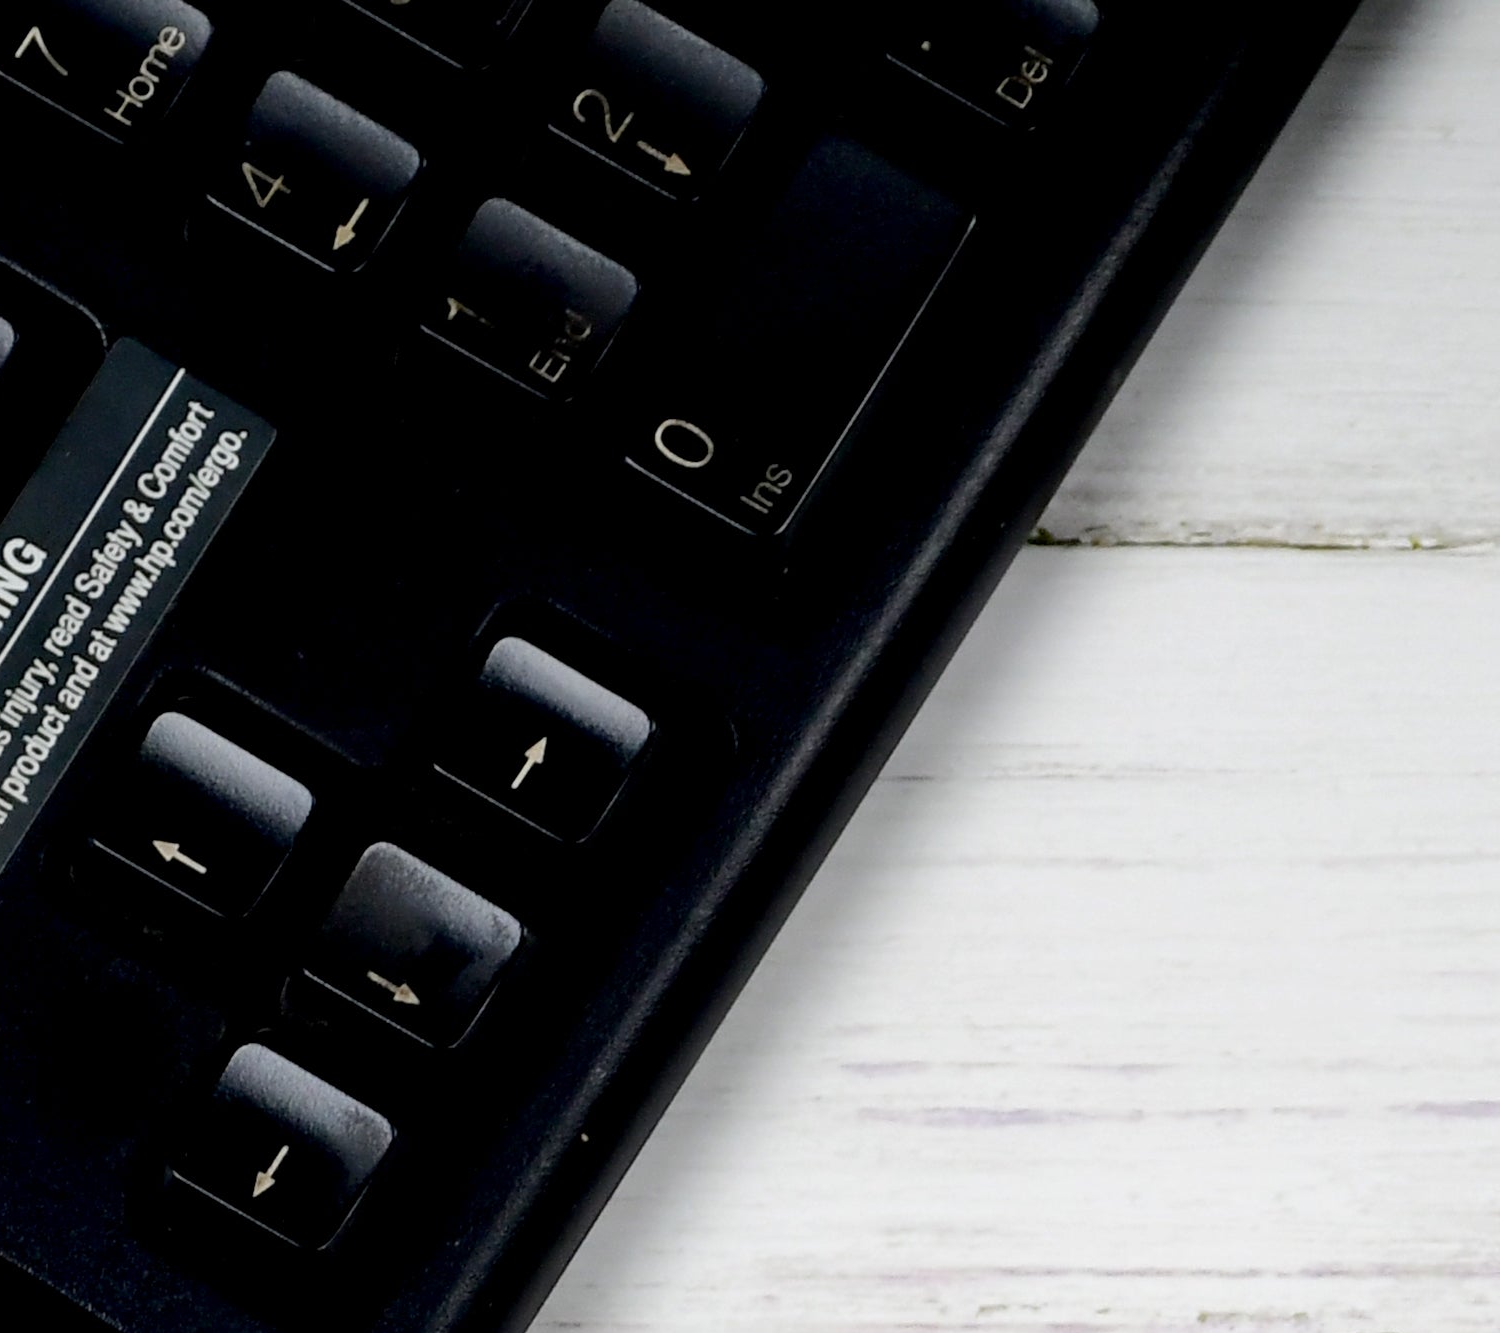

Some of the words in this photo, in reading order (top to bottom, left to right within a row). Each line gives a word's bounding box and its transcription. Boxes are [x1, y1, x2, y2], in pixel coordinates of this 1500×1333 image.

[14, 25, 69, 77] 7
[103, 25, 186, 127] Home
[995, 44, 1055, 111] Del
[571, 87, 636, 145] 2
[241, 161, 292, 208] 4
[137, 401, 215, 500] Comfort
[653, 418, 715, 470] 0
[123, 499, 155, 524] &
[739, 461, 795, 516] Ins
[74, 519, 143, 599] Safety
[102, 431, 248, 634] www.hp.com/ergo.
[43, 594, 92, 657] read
[87, 629, 118, 662] at
[57, 655, 100, 710] and
[1, 704, 71, 804] product
